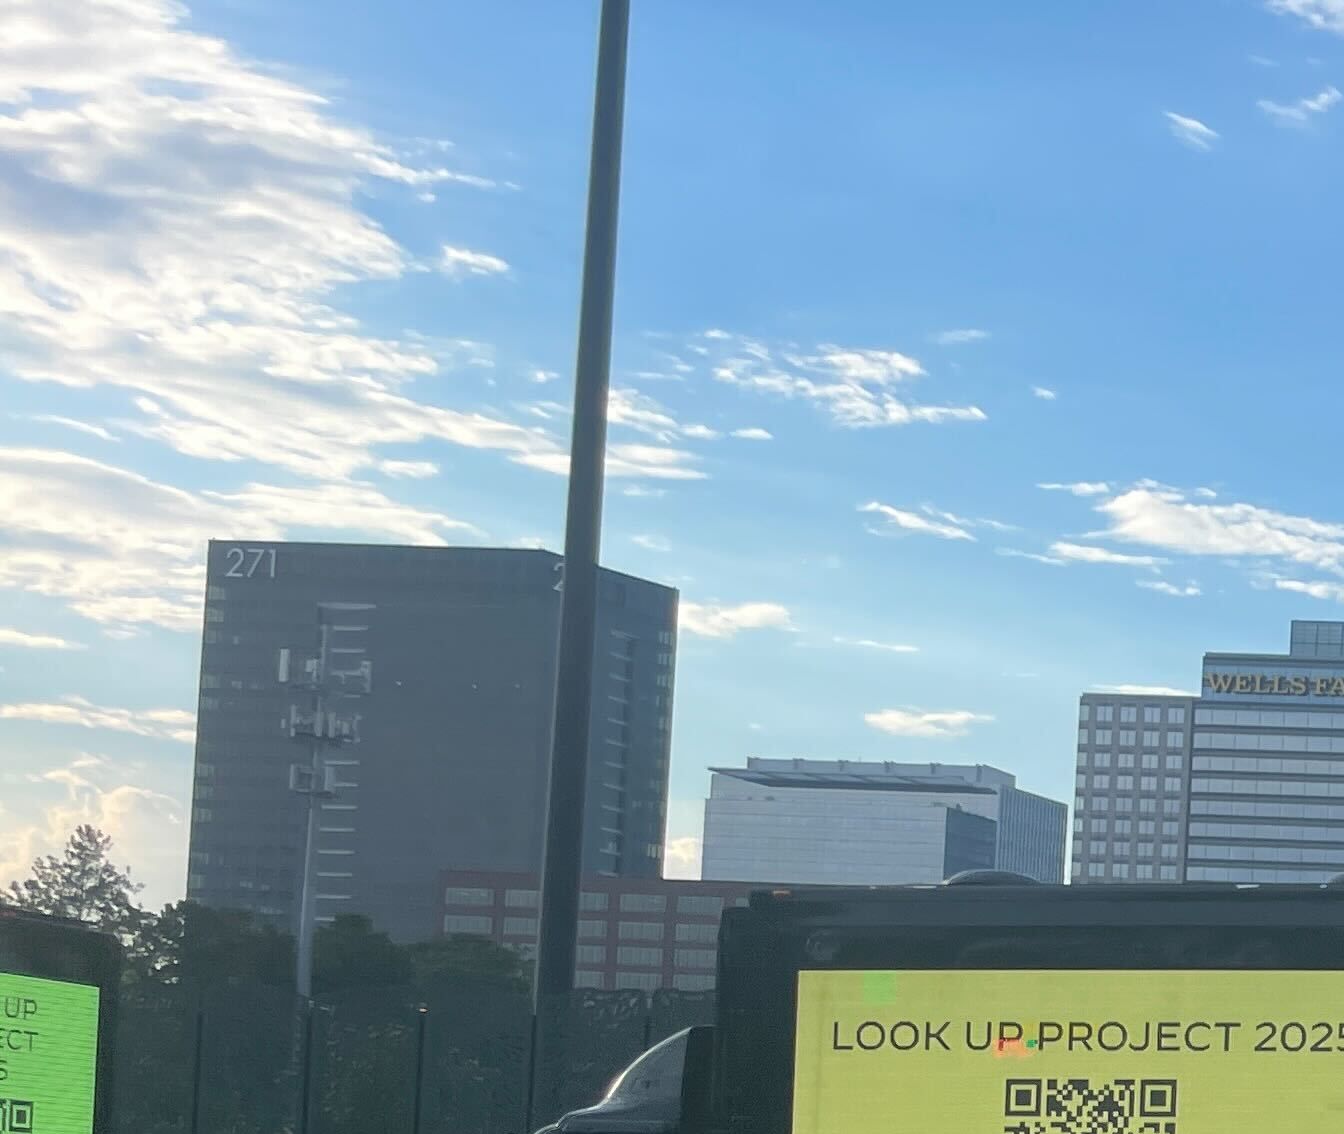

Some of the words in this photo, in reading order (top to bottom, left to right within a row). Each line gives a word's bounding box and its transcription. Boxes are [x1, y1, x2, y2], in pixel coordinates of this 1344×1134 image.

[224, 548, 277, 579] 271
[1205, 671, 1307, 695] WELLS
[5, 996, 38, 1020] UP
[833, 1021, 951, 1052] LOOK
[966, 1021, 1024, 1052] UP
[1038, 1021, 1242, 1052] PROJECT
